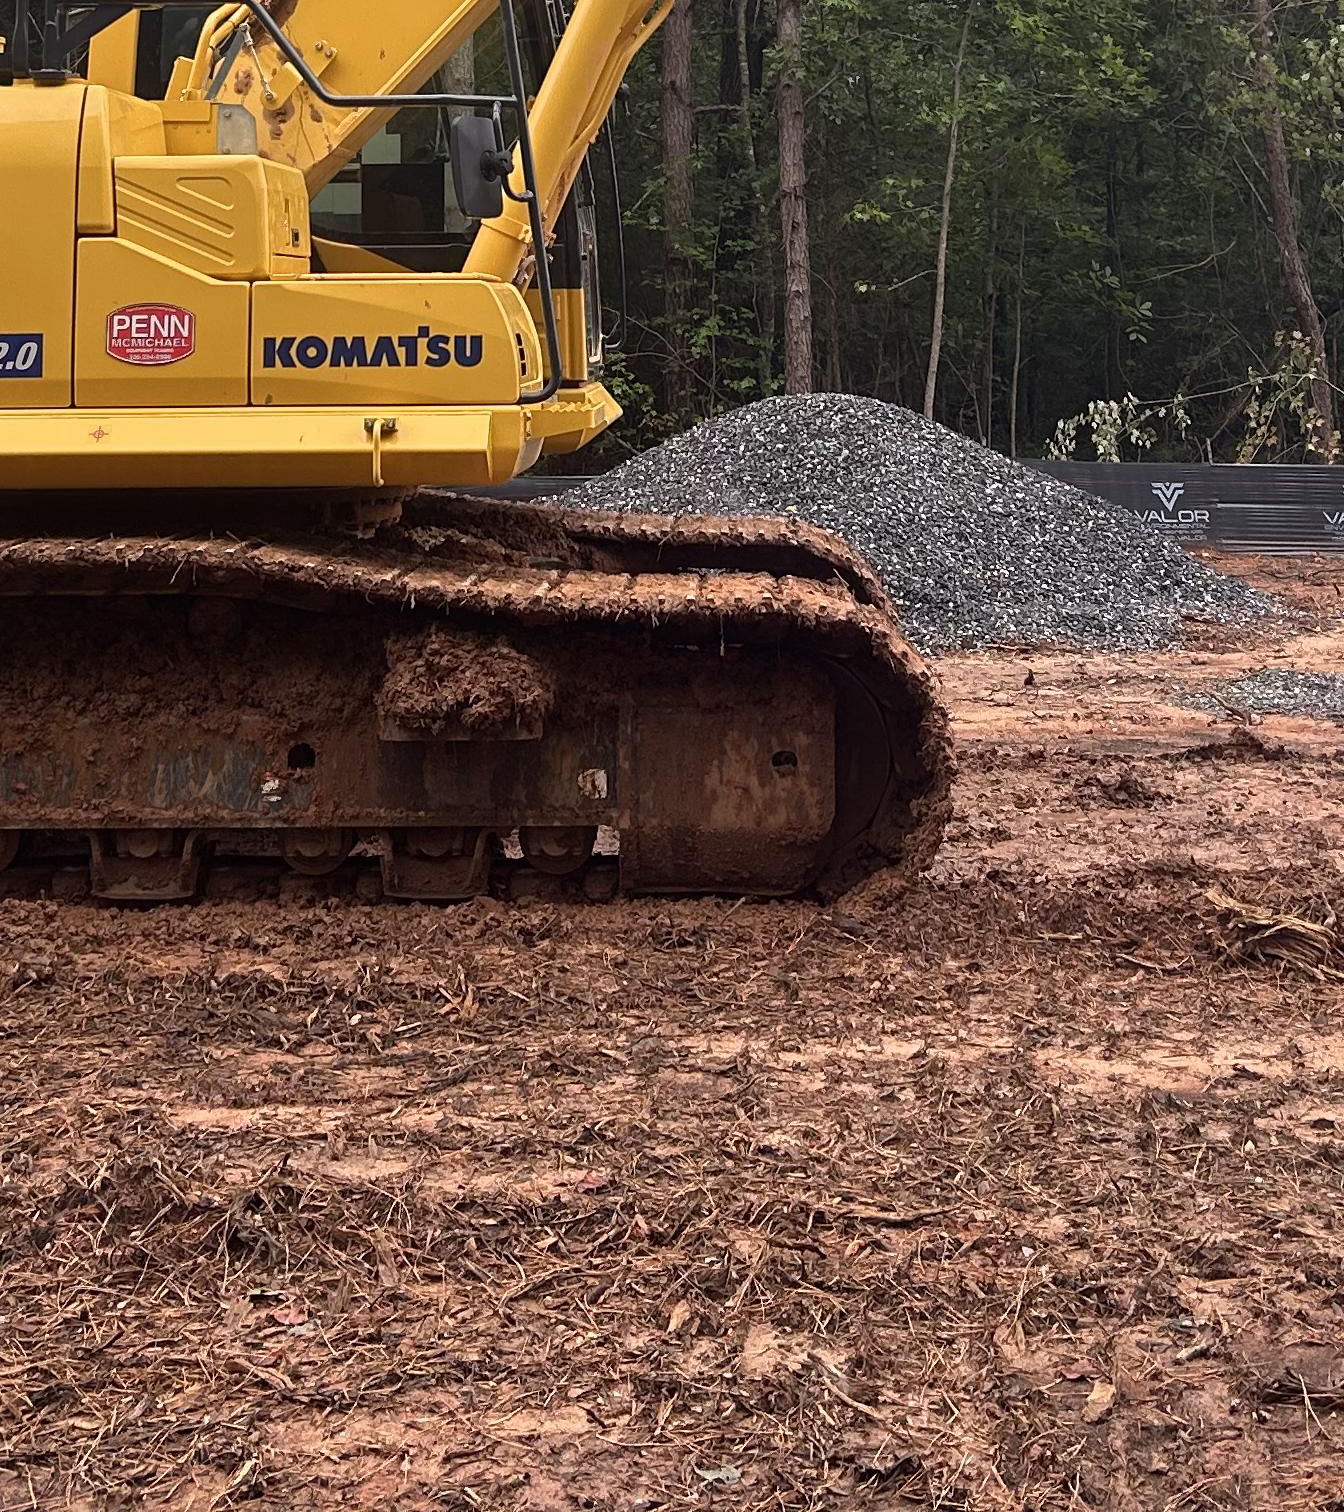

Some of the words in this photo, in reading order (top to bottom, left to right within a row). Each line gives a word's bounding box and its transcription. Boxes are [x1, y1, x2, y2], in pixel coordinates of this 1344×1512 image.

[112, 314, 190, 338] PENN
[111, 338, 190, 348] MCMICHAEL
[262, 326, 484, 369] KOMATSU
[1134, 509, 1210, 523] VALOR
